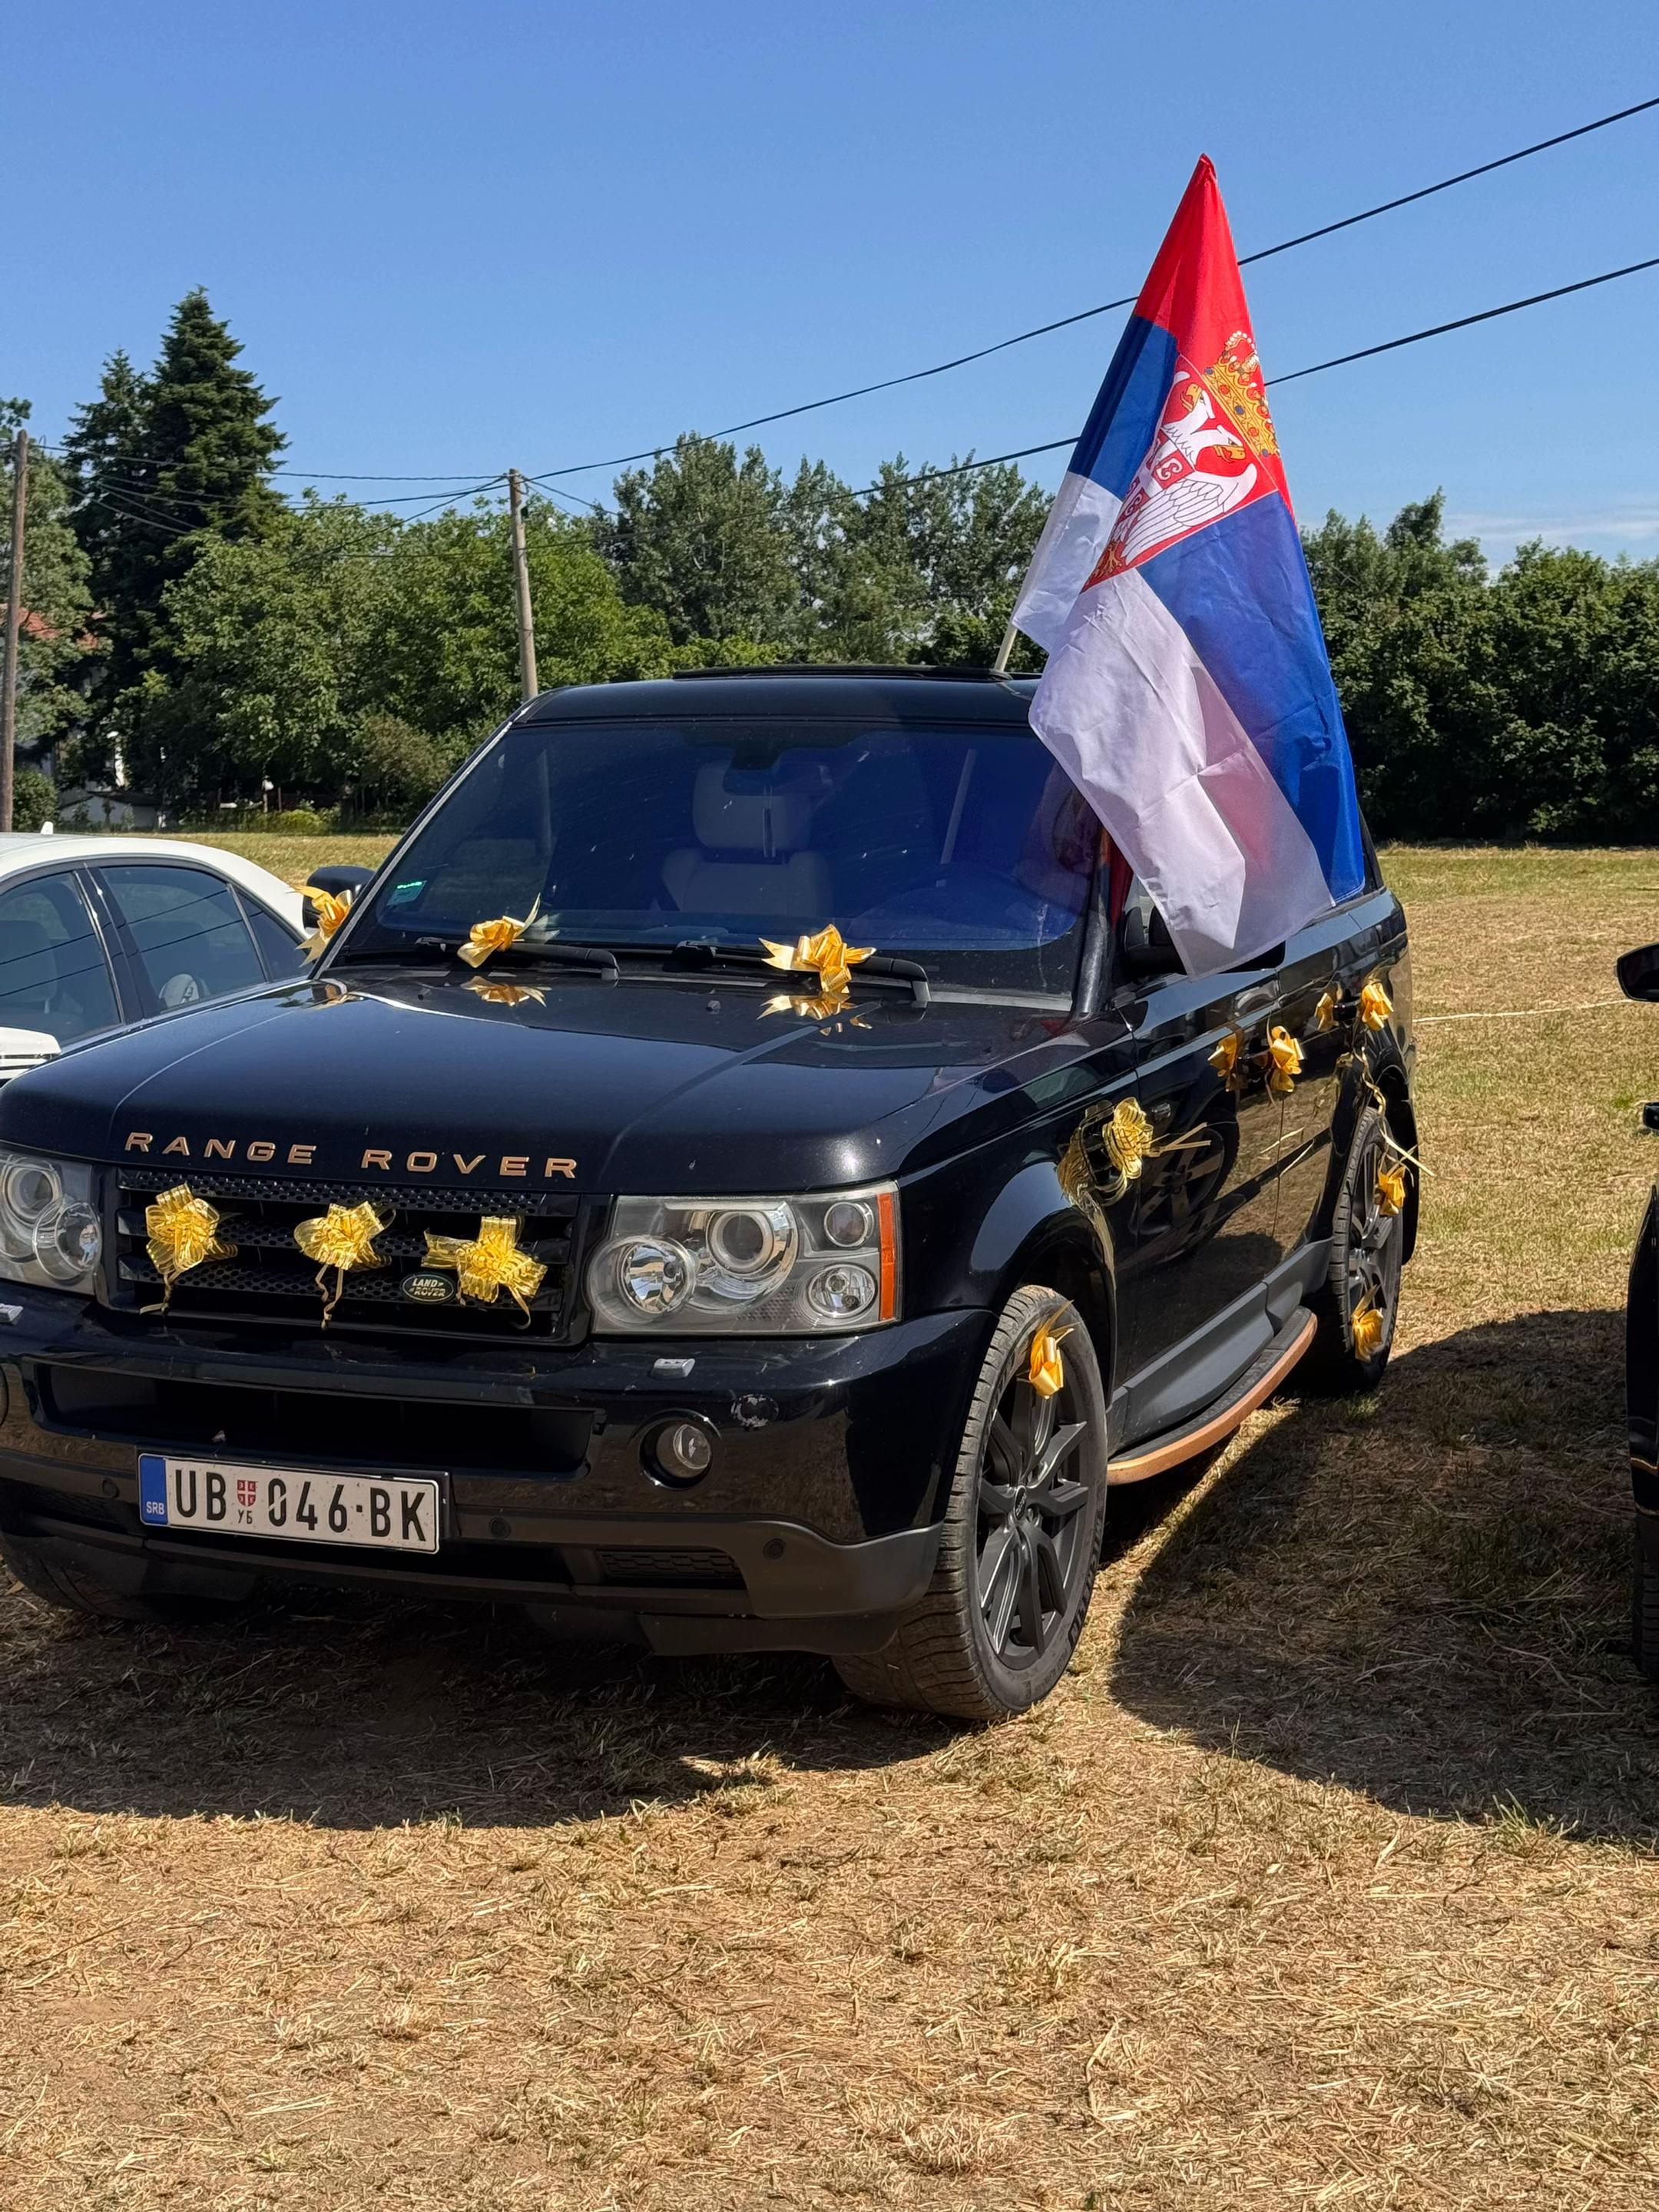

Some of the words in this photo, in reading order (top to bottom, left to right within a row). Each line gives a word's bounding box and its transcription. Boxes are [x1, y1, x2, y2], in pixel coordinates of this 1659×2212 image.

[125, 1132, 316, 1164] RANGE
[361, 1150, 578, 1179] ROVER
[412, 1278, 438, 1287] LAND
[414, 1287, 445, 1296] ROVER
[175, 1469, 227, 1521] UB
[146, 1501, 164, 1515] SRB
